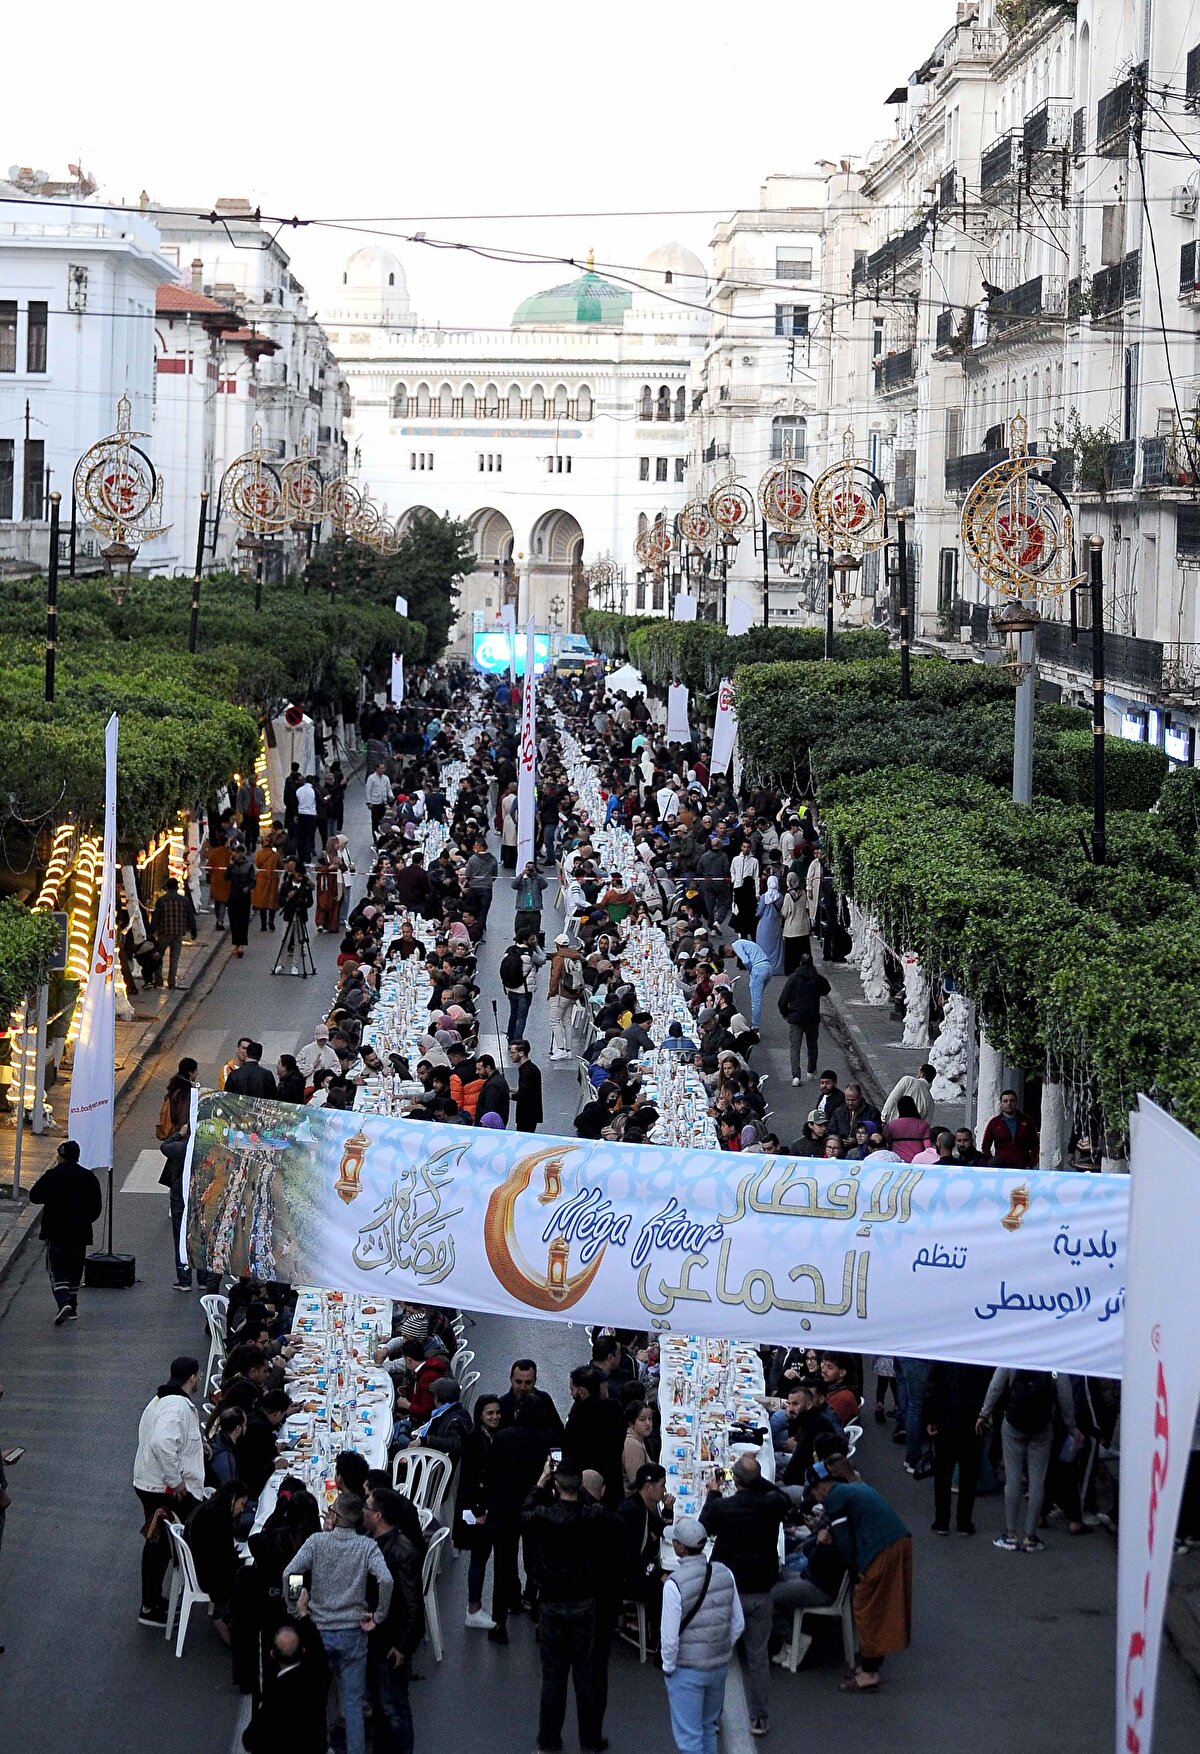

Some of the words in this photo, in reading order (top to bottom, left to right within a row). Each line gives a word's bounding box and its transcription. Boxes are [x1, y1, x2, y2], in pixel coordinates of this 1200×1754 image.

[542, 1187, 632, 1263] Méga
[631, 1197, 724, 1268] ftour
[717, 1159, 925, 1238] الإفطار
[912, 1243, 967, 1273] تنظم
[1053, 1224, 1117, 1269] بلدية
[637, 1236, 871, 1331] الجماعي
[975, 1281, 1092, 1320] الوسطى
